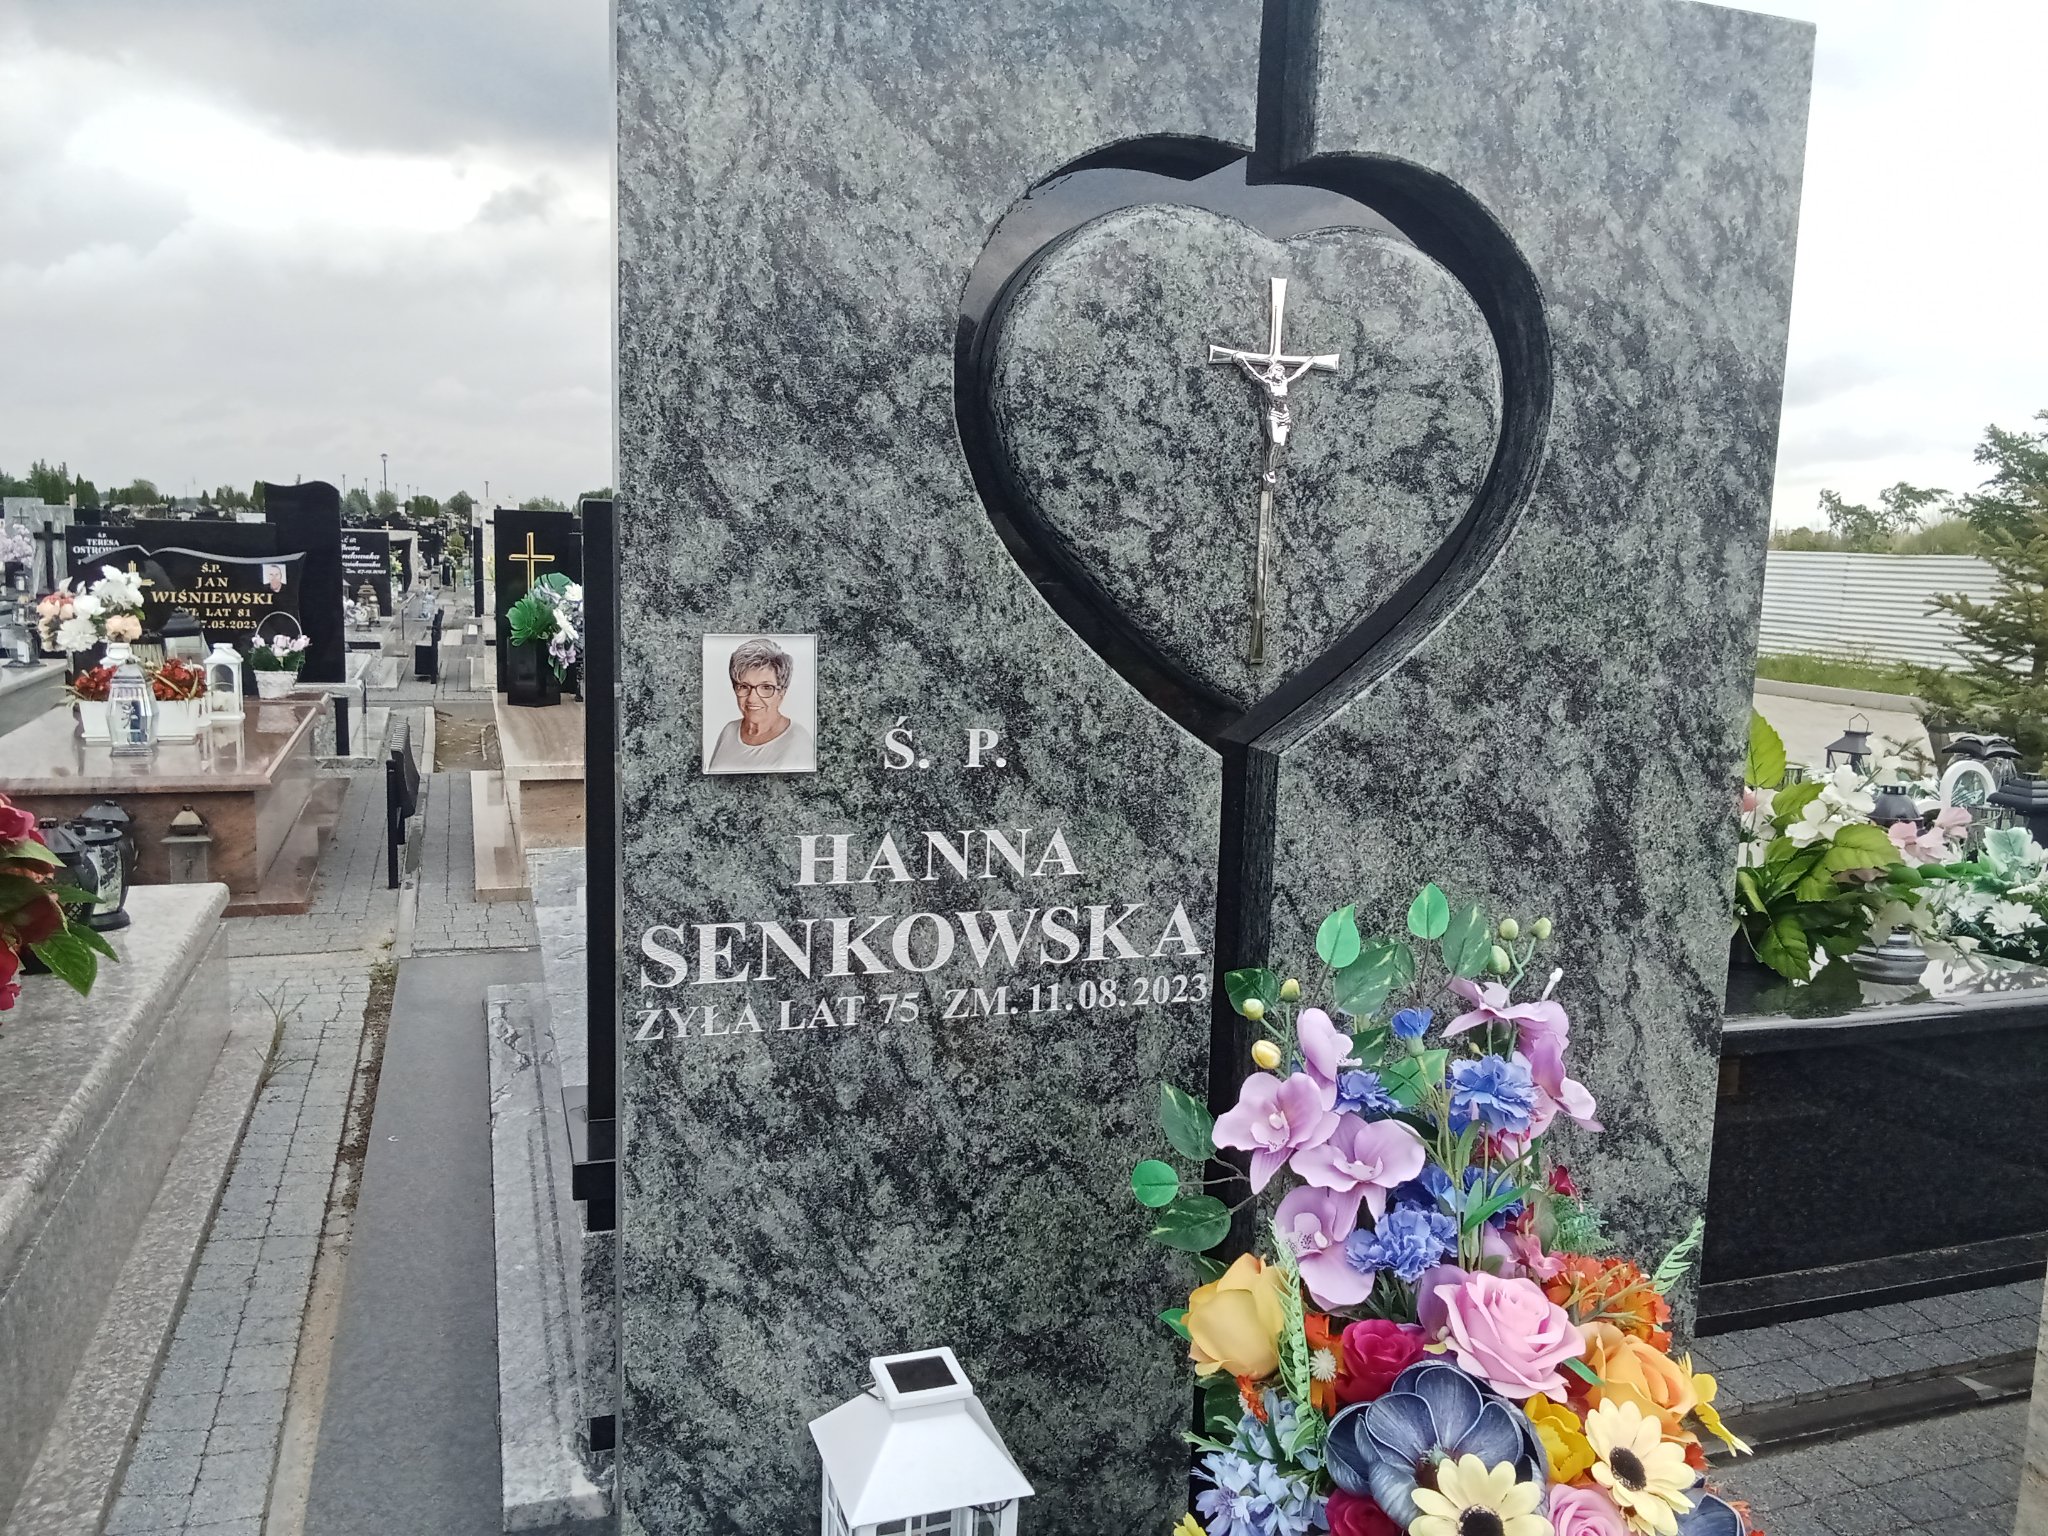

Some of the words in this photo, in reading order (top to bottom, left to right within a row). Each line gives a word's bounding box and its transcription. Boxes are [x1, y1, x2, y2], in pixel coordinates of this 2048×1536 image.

[86, 538, 120, 547] TERESA
[195, 576, 229, 589] JAN
[150, 588, 274, 605] WIŚNIEWSKI
[205, 607, 232, 617] LAT
[237, 608, 252, 617] 81
[200, 619, 258, 630] 7.05.2023
[883, 716, 930, 770] Ś.
[964, 728, 1007, 769] P.
[793, 827, 1083, 886] HANNA
[639, 901, 1206, 990] SENKOWSKA
[633, 1001, 766, 1041] ŻYŁA
[776, 995, 866, 1031] LAT
[878, 991, 920, 1024] 75
[1028, 973, 1208, 1013] 11.08.2023
